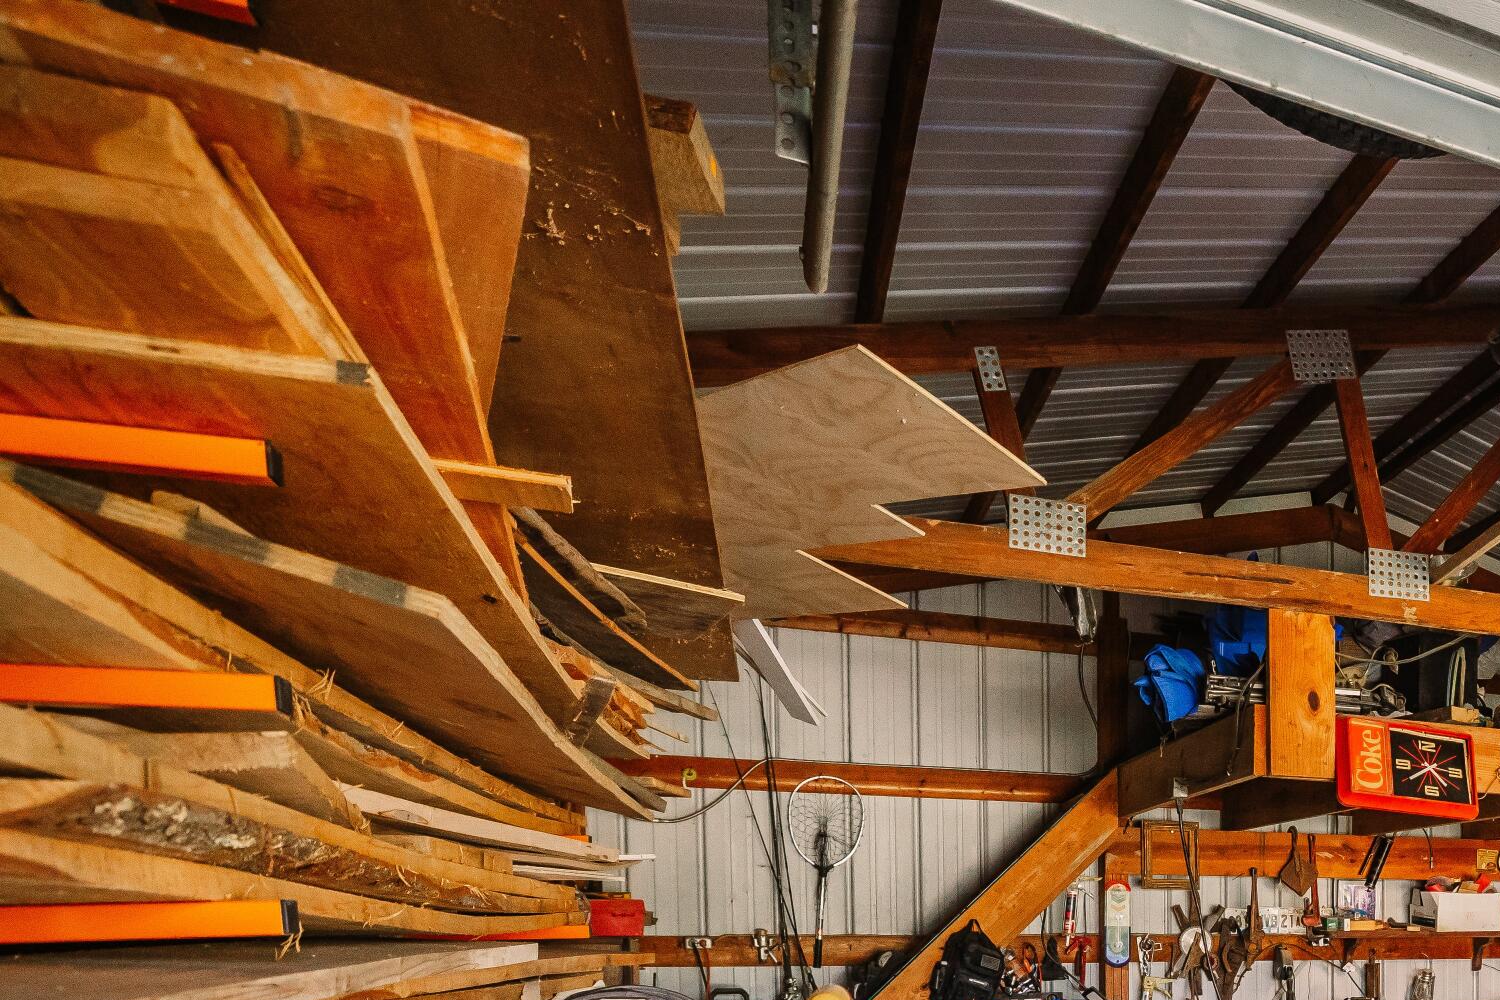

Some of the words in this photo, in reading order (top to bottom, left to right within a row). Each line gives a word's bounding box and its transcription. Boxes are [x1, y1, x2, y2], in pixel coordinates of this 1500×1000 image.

[1418, 740, 1436, 753] 12
[1354, 729, 1383, 789] Coke
[1424, 785, 1440, 797] 6
